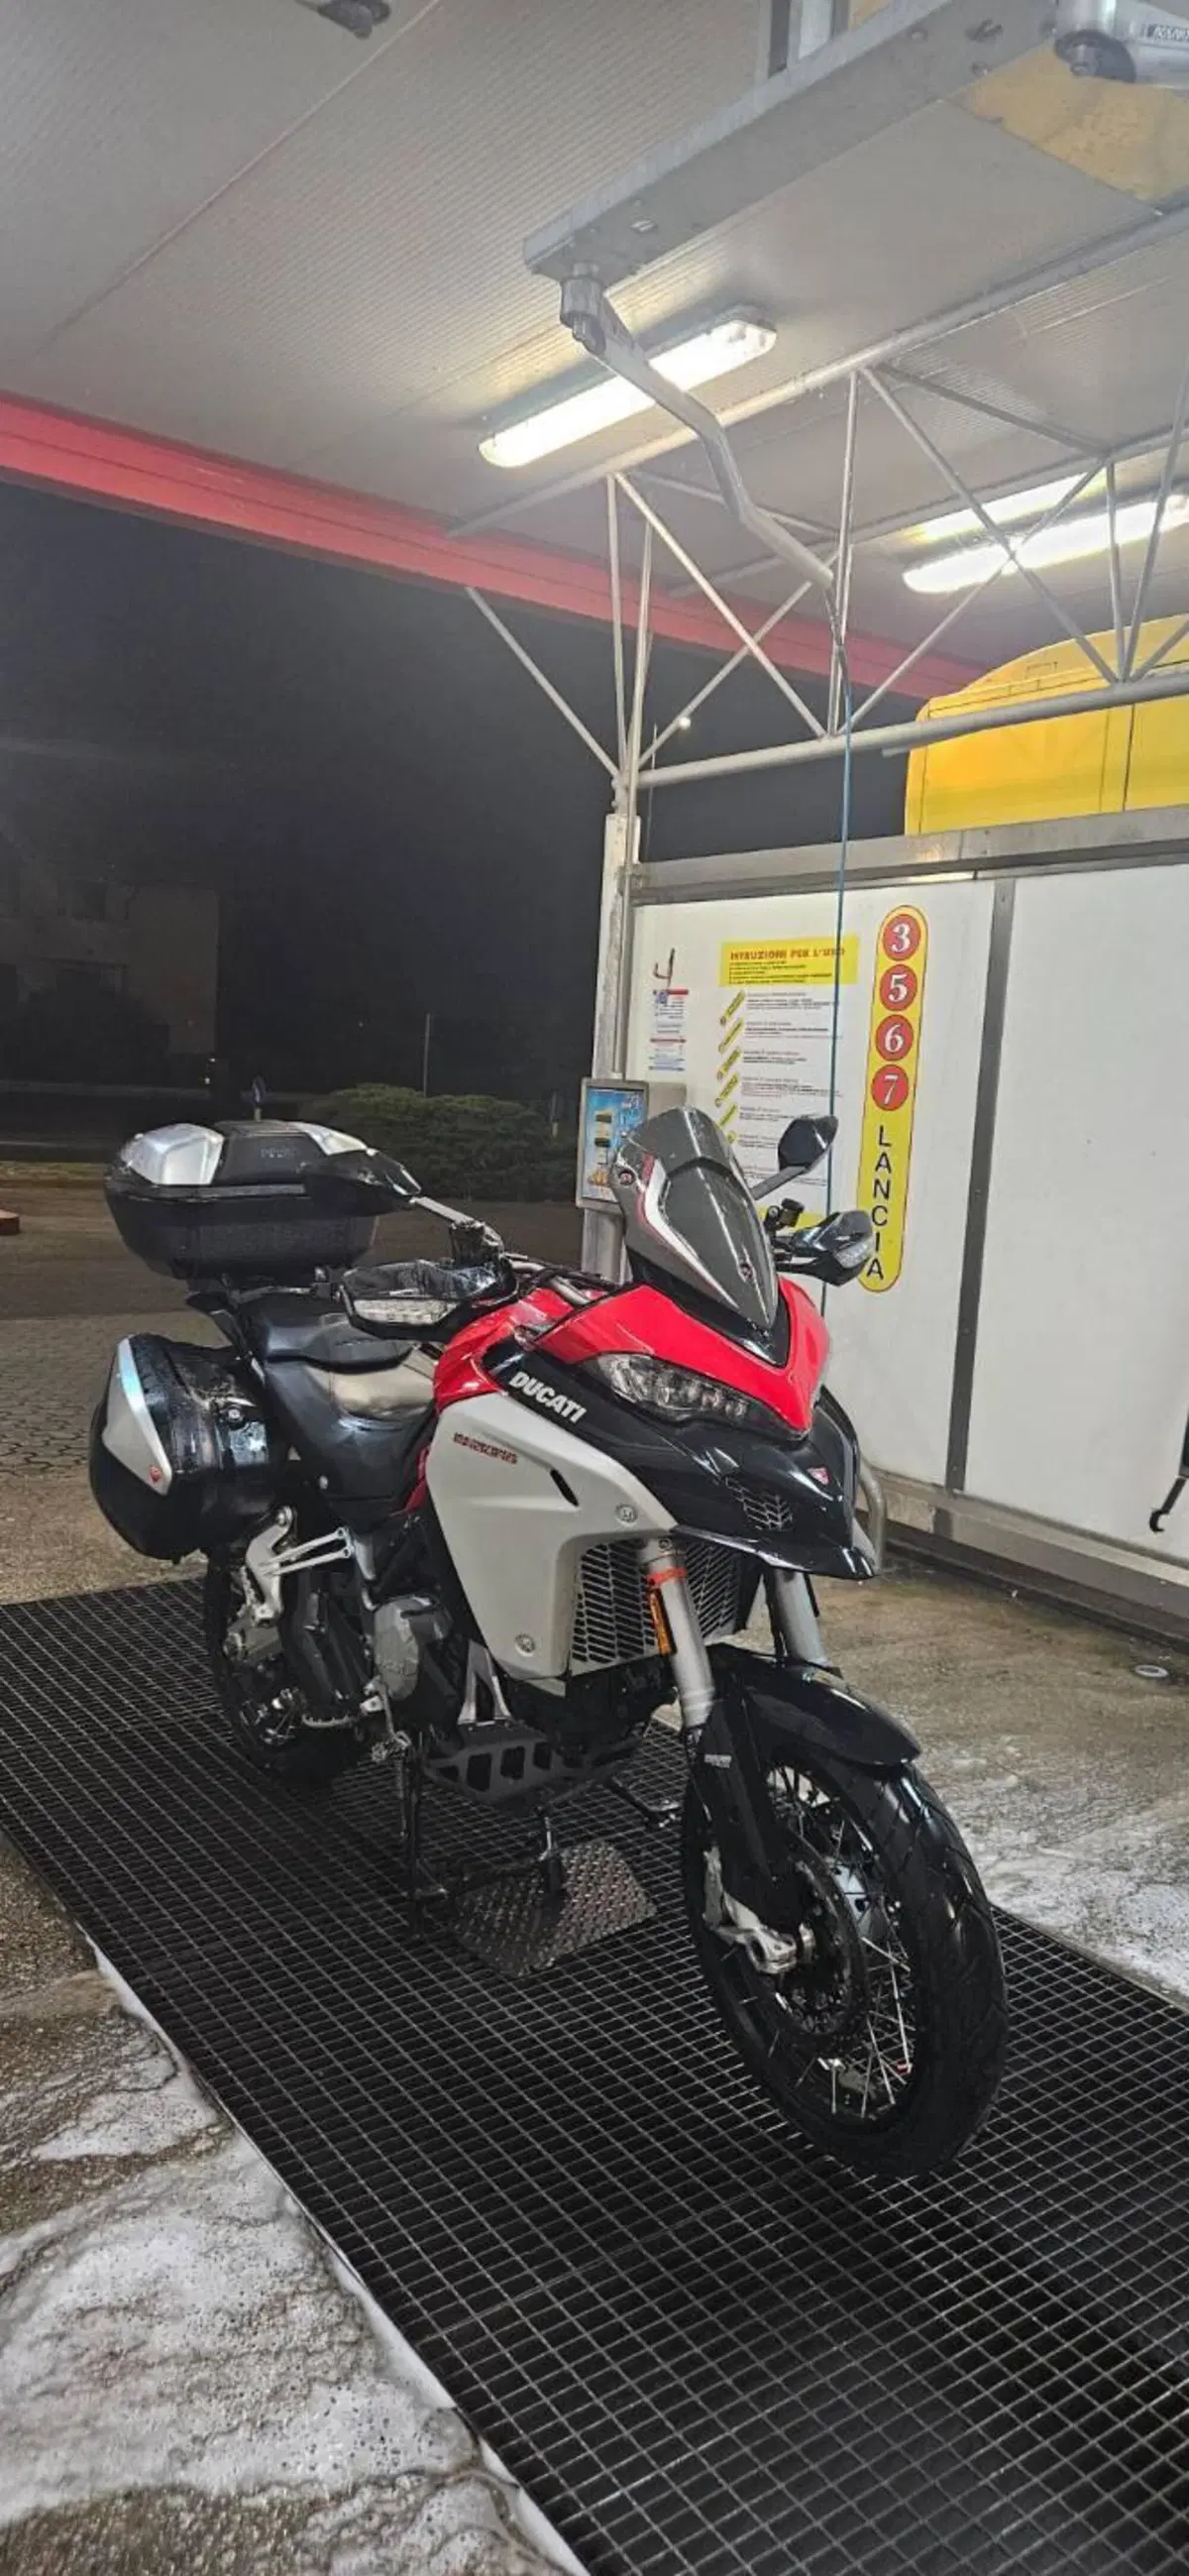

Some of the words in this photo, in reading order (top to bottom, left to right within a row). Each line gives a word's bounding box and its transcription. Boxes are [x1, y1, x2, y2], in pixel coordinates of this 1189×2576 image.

[891, 923, 911, 952] 3
[888, 973, 908, 1003] 5
[885, 1023, 904, 1053] 6
[883, 1073, 899, 1104] 7
[866, 1124, 892, 1281] LANCIA
[509, 1372, 587, 1423] DUCATI
